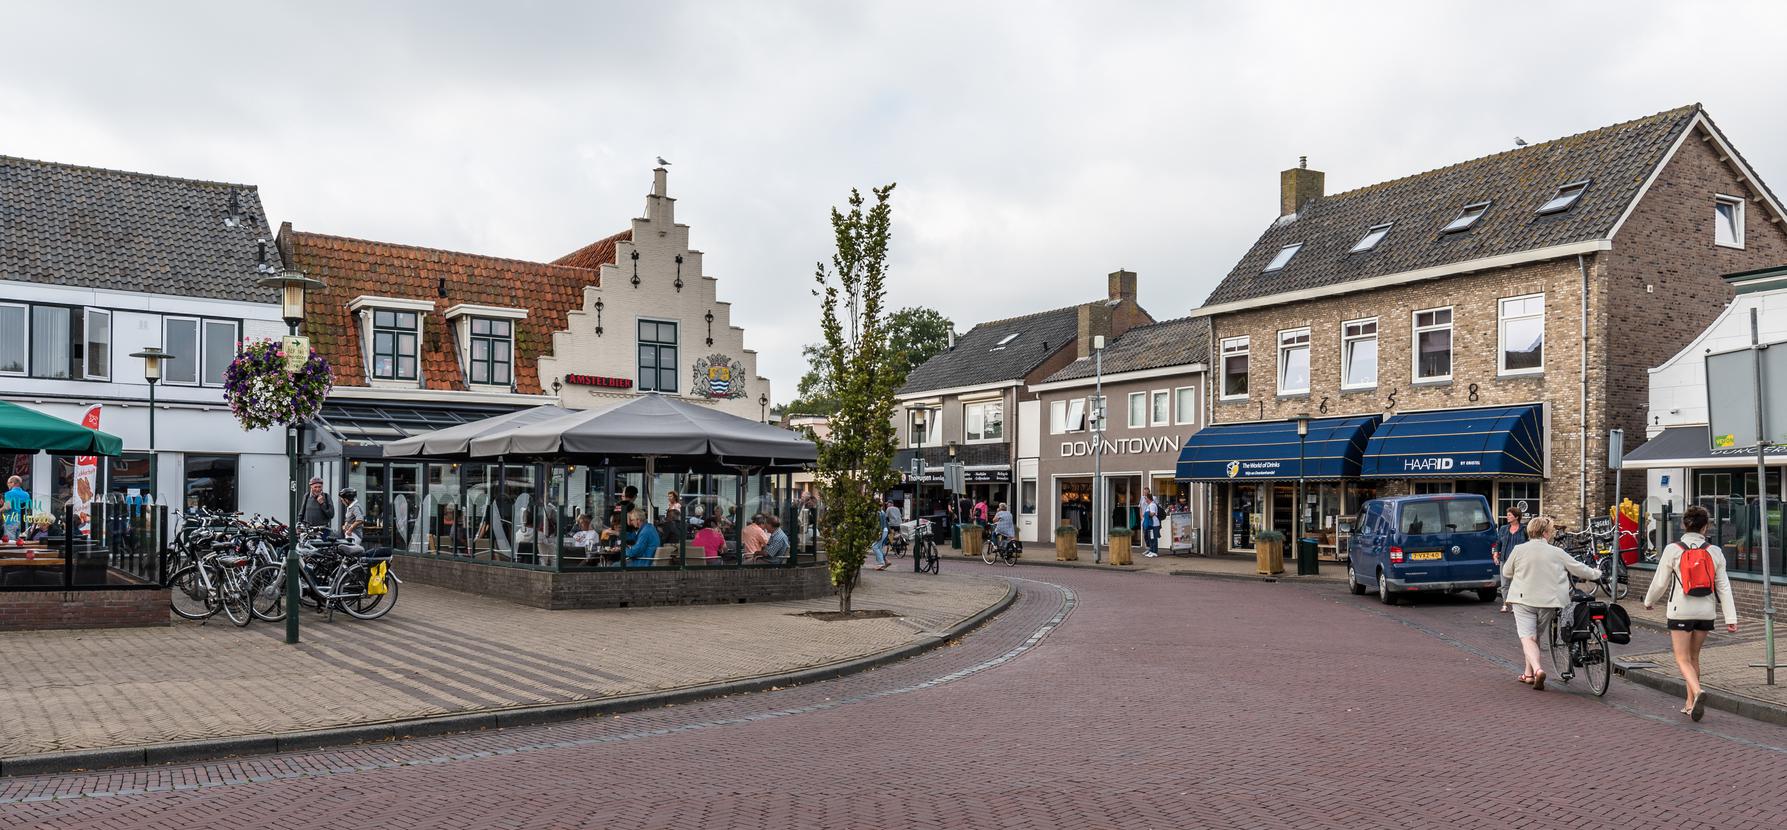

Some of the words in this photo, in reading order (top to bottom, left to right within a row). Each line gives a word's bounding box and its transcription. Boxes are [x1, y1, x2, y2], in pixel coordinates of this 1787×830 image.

[569, 373, 608, 386] AMSTEL
[609, 377, 631, 388] BIER
[1061, 435, 1179, 457] DOWNTOWN
[1404, 458, 1454, 470] HAARID
